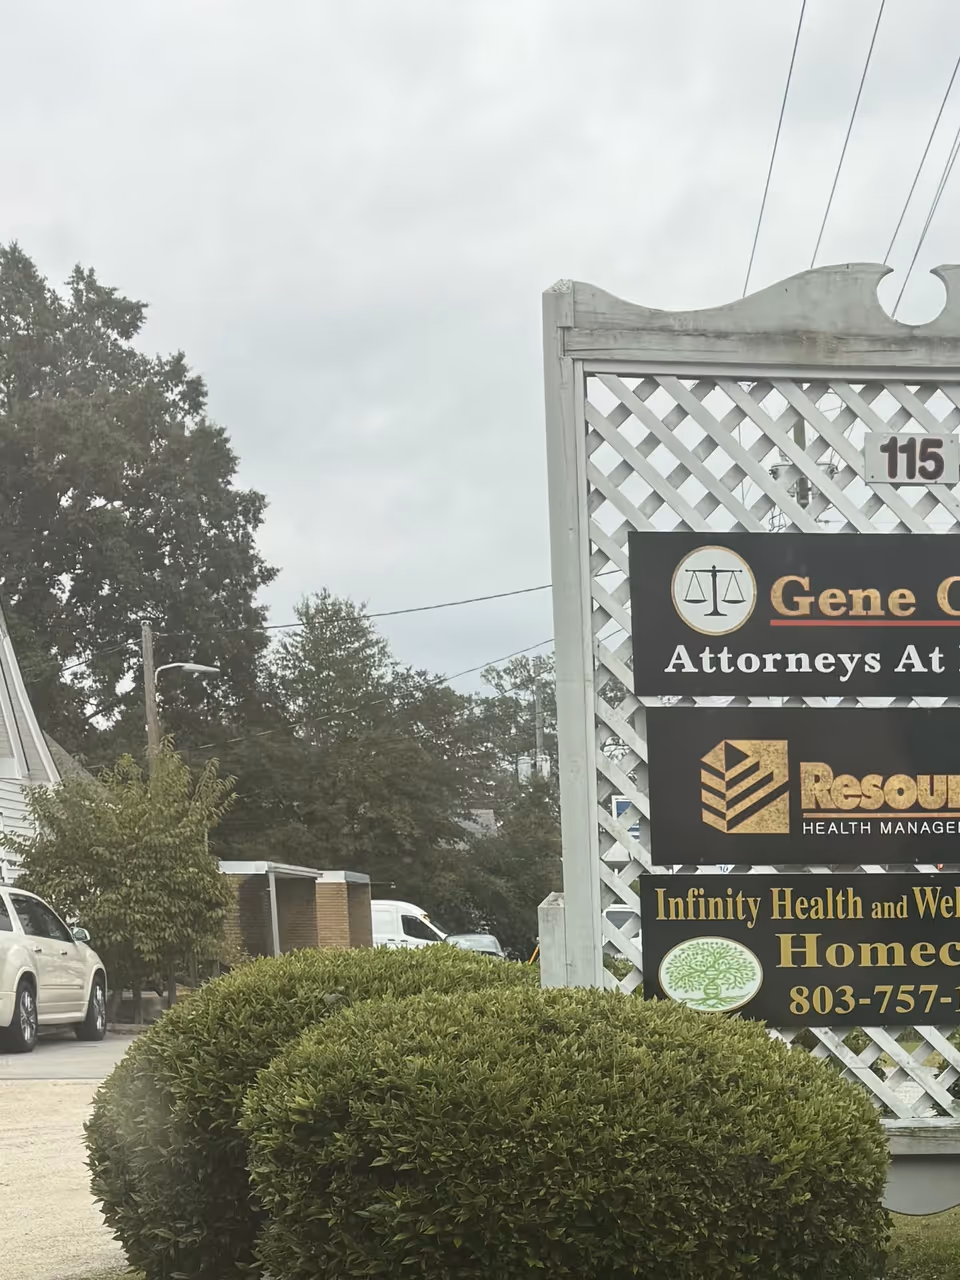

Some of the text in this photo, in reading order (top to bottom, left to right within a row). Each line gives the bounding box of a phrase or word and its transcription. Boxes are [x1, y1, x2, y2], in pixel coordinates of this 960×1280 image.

[879, 436, 945, 480] 115
[770, 574, 917, 617] Gene
[663, 644, 882, 682] Attorneys
[893, 644, 946, 674] At
[802, 821, 871, 835] HEALTH
[654, 887, 762, 929] Infinity
[769, 887, 864, 920] Health
[871, 894, 909, 919] and
